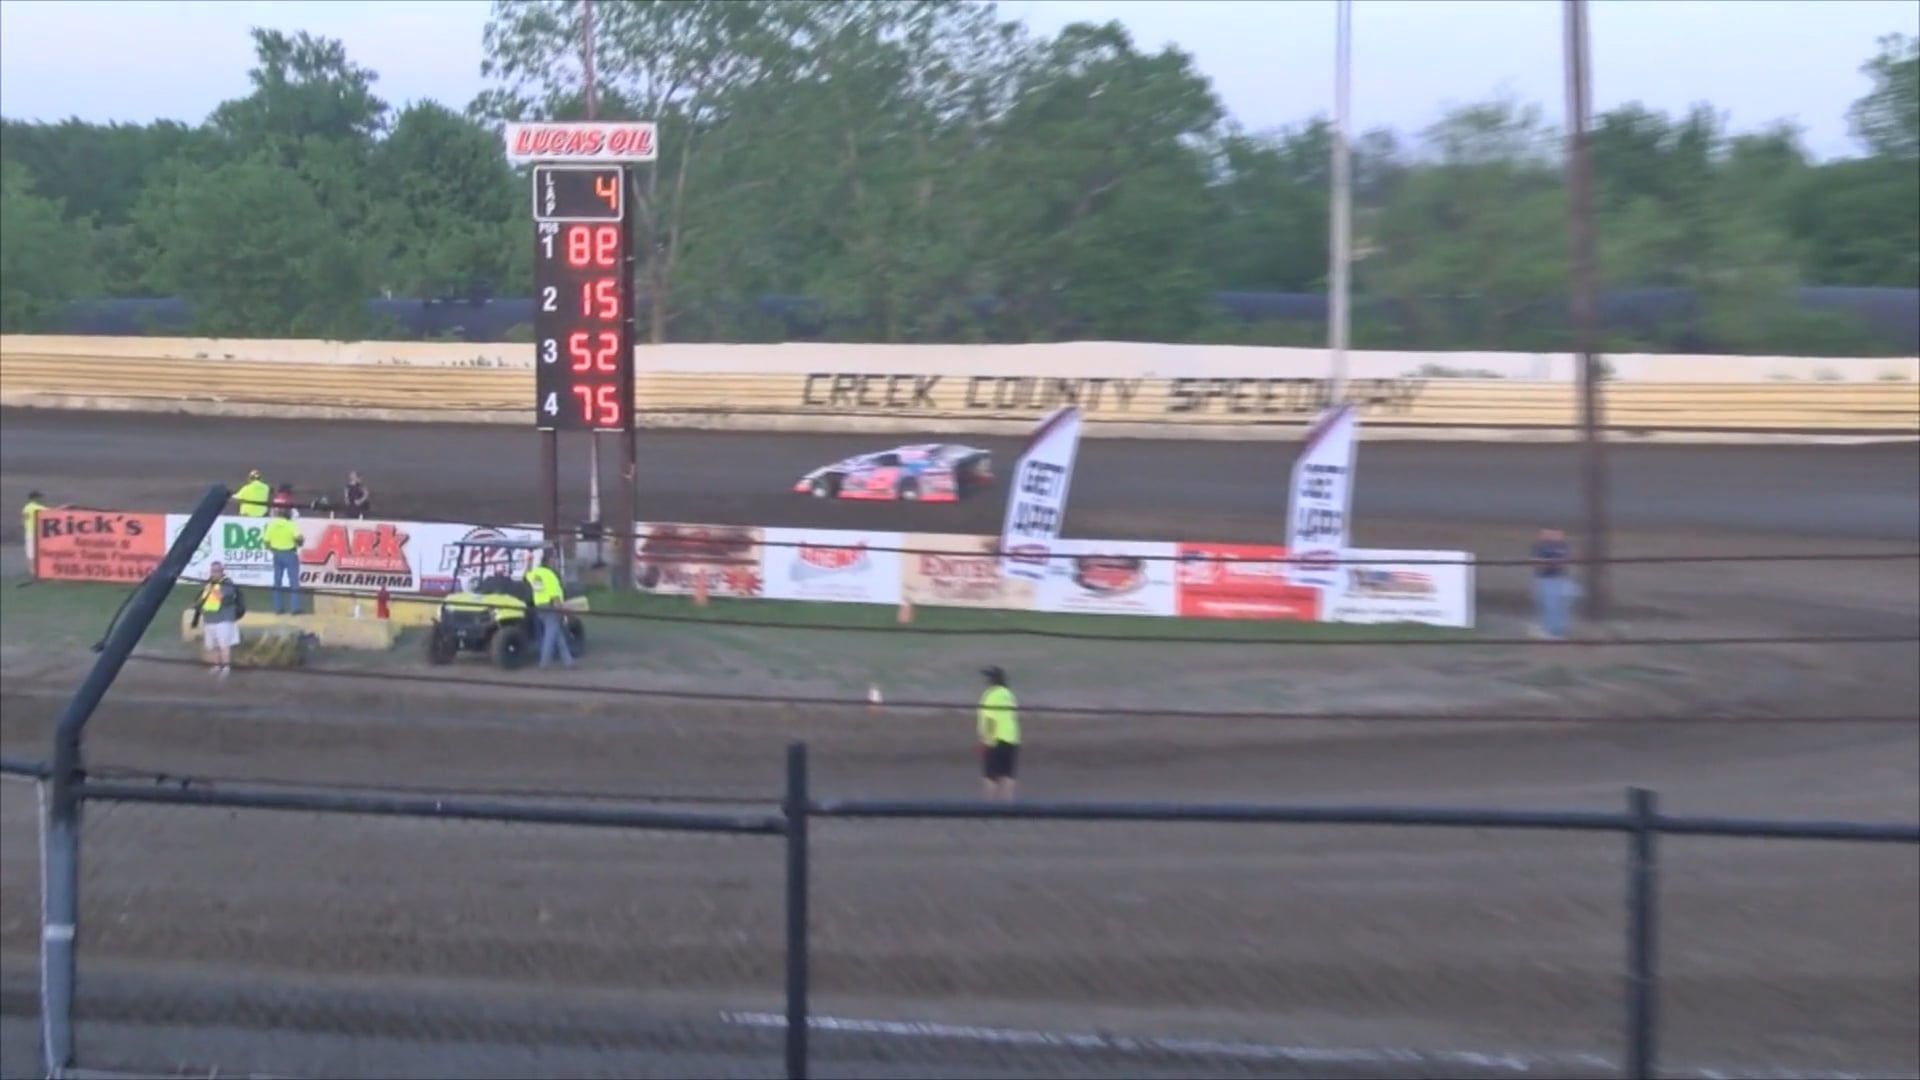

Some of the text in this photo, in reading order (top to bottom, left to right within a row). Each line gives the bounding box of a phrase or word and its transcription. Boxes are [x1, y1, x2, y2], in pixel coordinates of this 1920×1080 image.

[513, 127, 654, 155] LUCAS OIL
[545, 171, 556, 216] LAP
[596, 176, 616, 209] 4
[542, 235, 553, 258] 1
[543, 287, 557, 312] 2
[584, 281, 618, 318] 15
[543, 339, 558, 363] 3
[570, 333, 618, 370] 52
[544, 392, 558, 416] 4
[573, 386, 619, 423] 75
[803, 373, 941, 407] CREEK
[964, 376, 1141, 411] COUNTY
[42, 515, 142, 537] Rick's
[223, 550, 274, 563] SUPPL
[300, 571, 413, 588] OF OKLAHOMA
